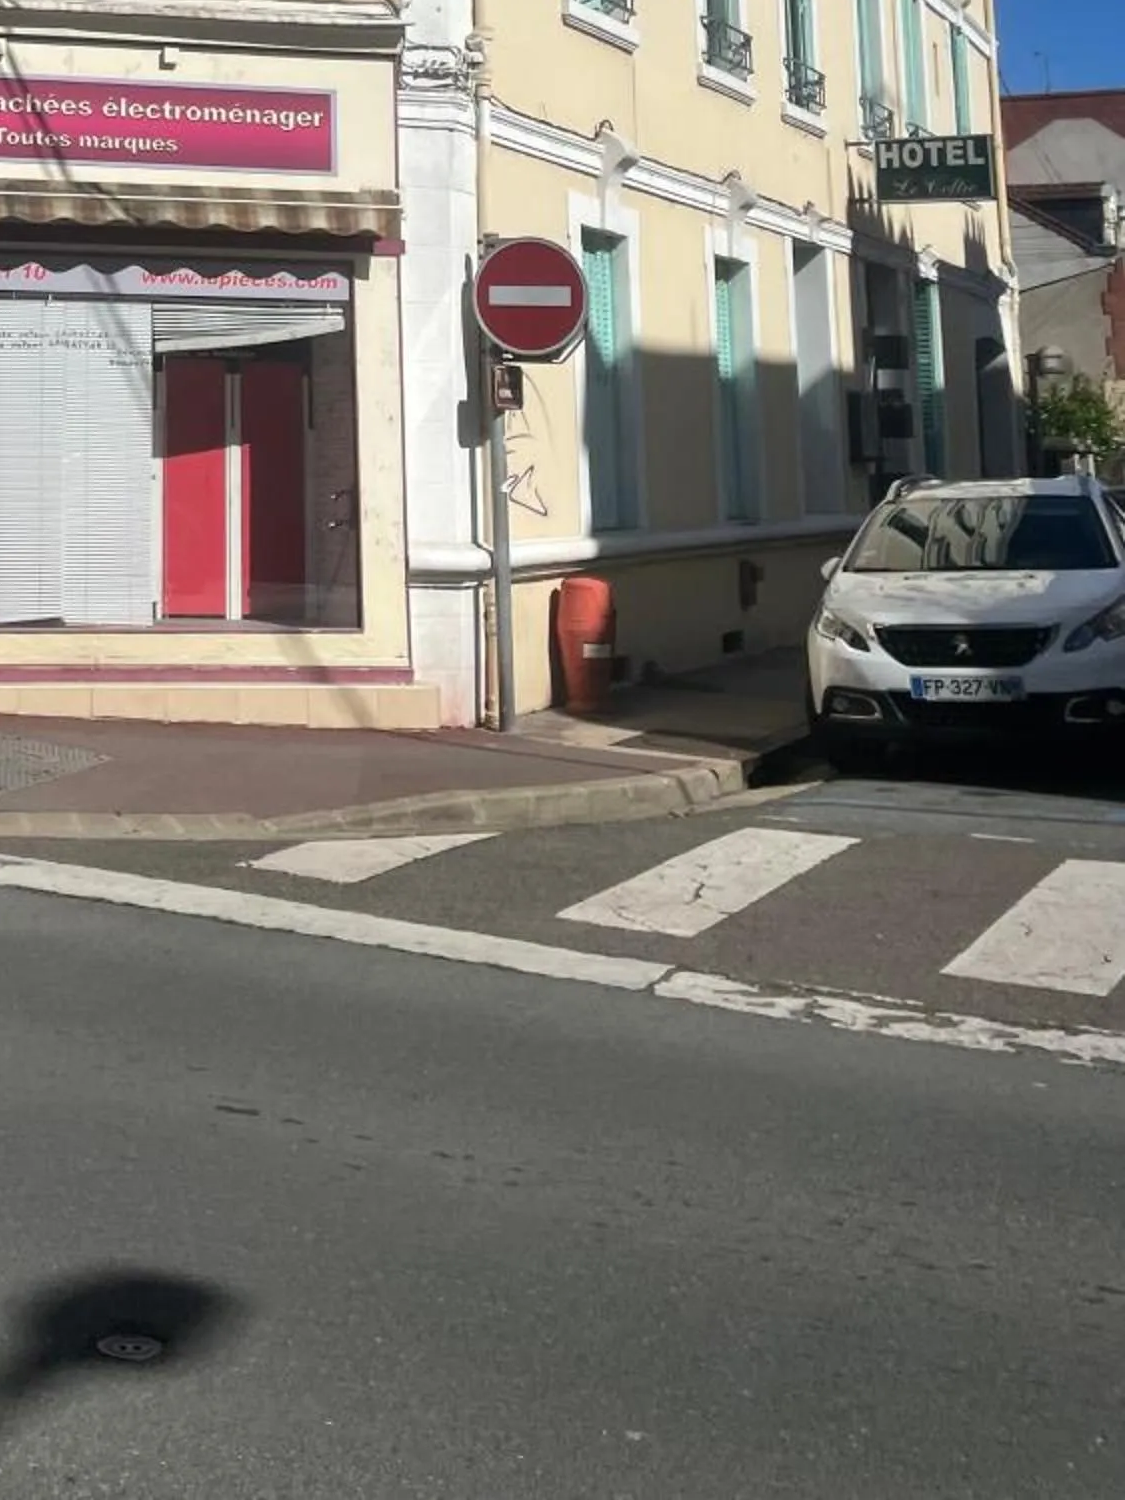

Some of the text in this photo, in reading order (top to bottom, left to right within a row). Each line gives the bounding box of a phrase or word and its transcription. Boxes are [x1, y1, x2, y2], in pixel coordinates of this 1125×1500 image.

[102, 96, 323, 131] électroménager
[79, 134, 179, 153] marques
[879, 139, 985, 169] HOTEL
[23, 264, 46, 281] 10
